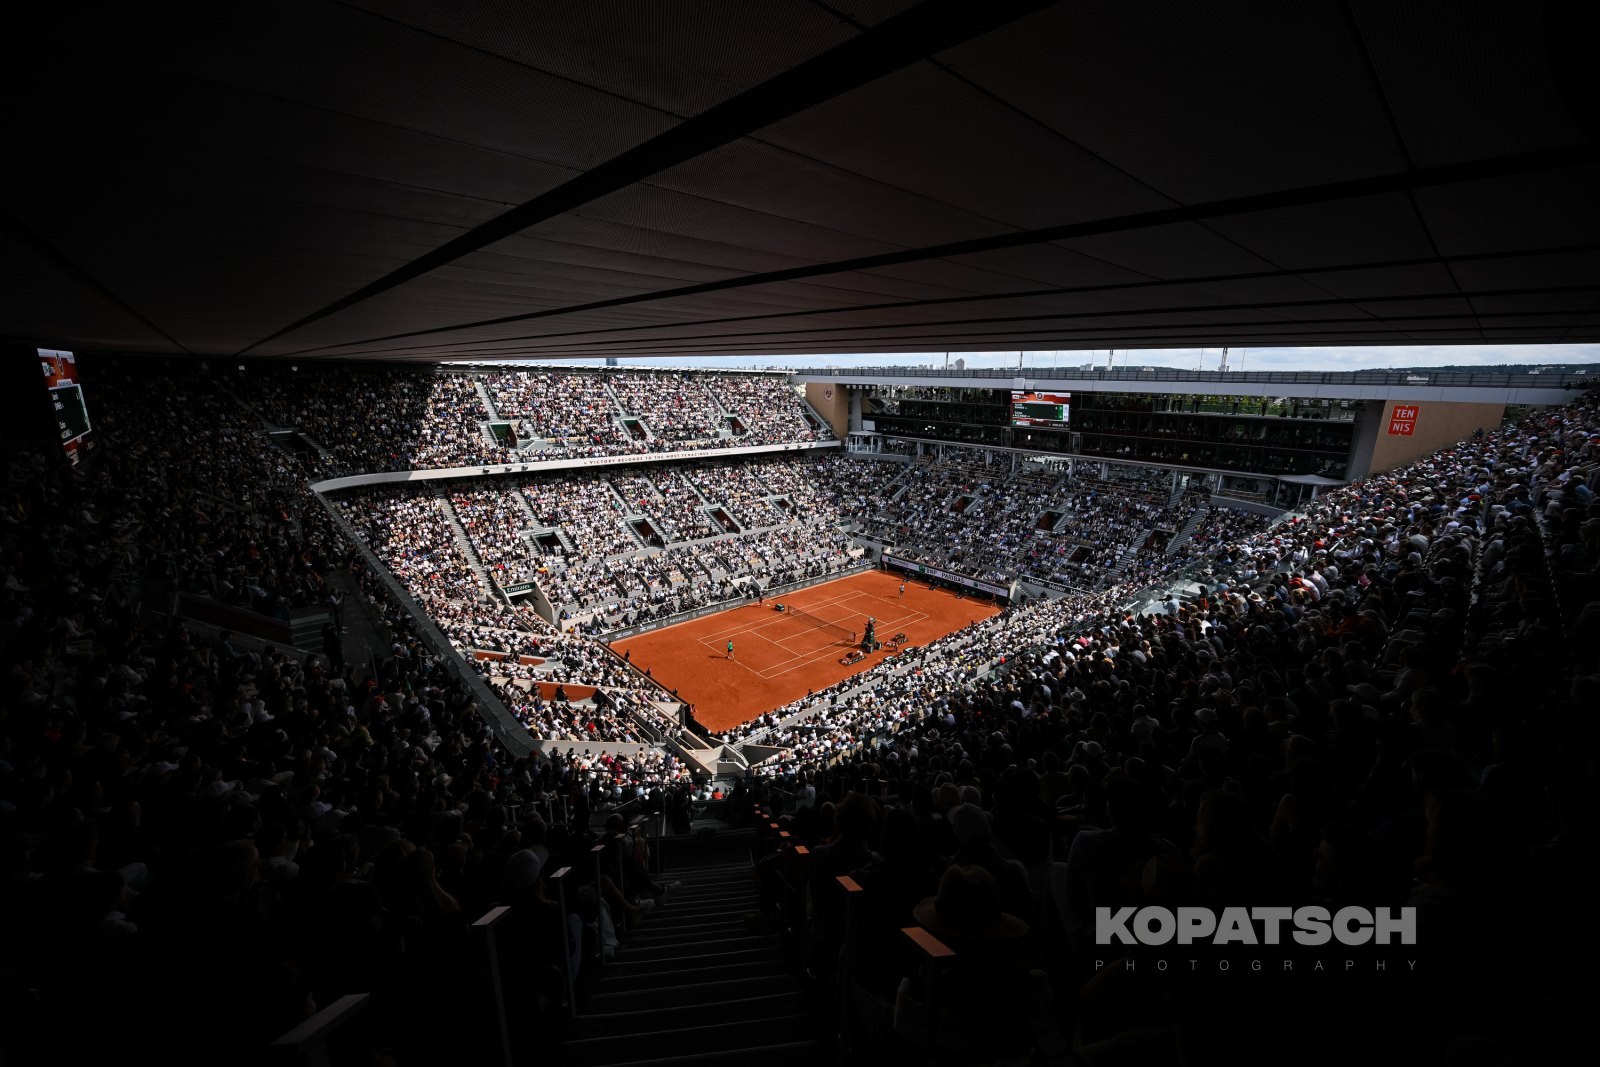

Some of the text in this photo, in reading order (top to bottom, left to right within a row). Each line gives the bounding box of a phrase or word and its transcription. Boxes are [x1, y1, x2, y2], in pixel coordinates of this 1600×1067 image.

[1396, 409, 1415, 418] TEN
[1392, 422, 1411, 432] NIS
[926, 567, 965, 584] BNP PARIBAS
[506, 584, 531, 593] Emirates
